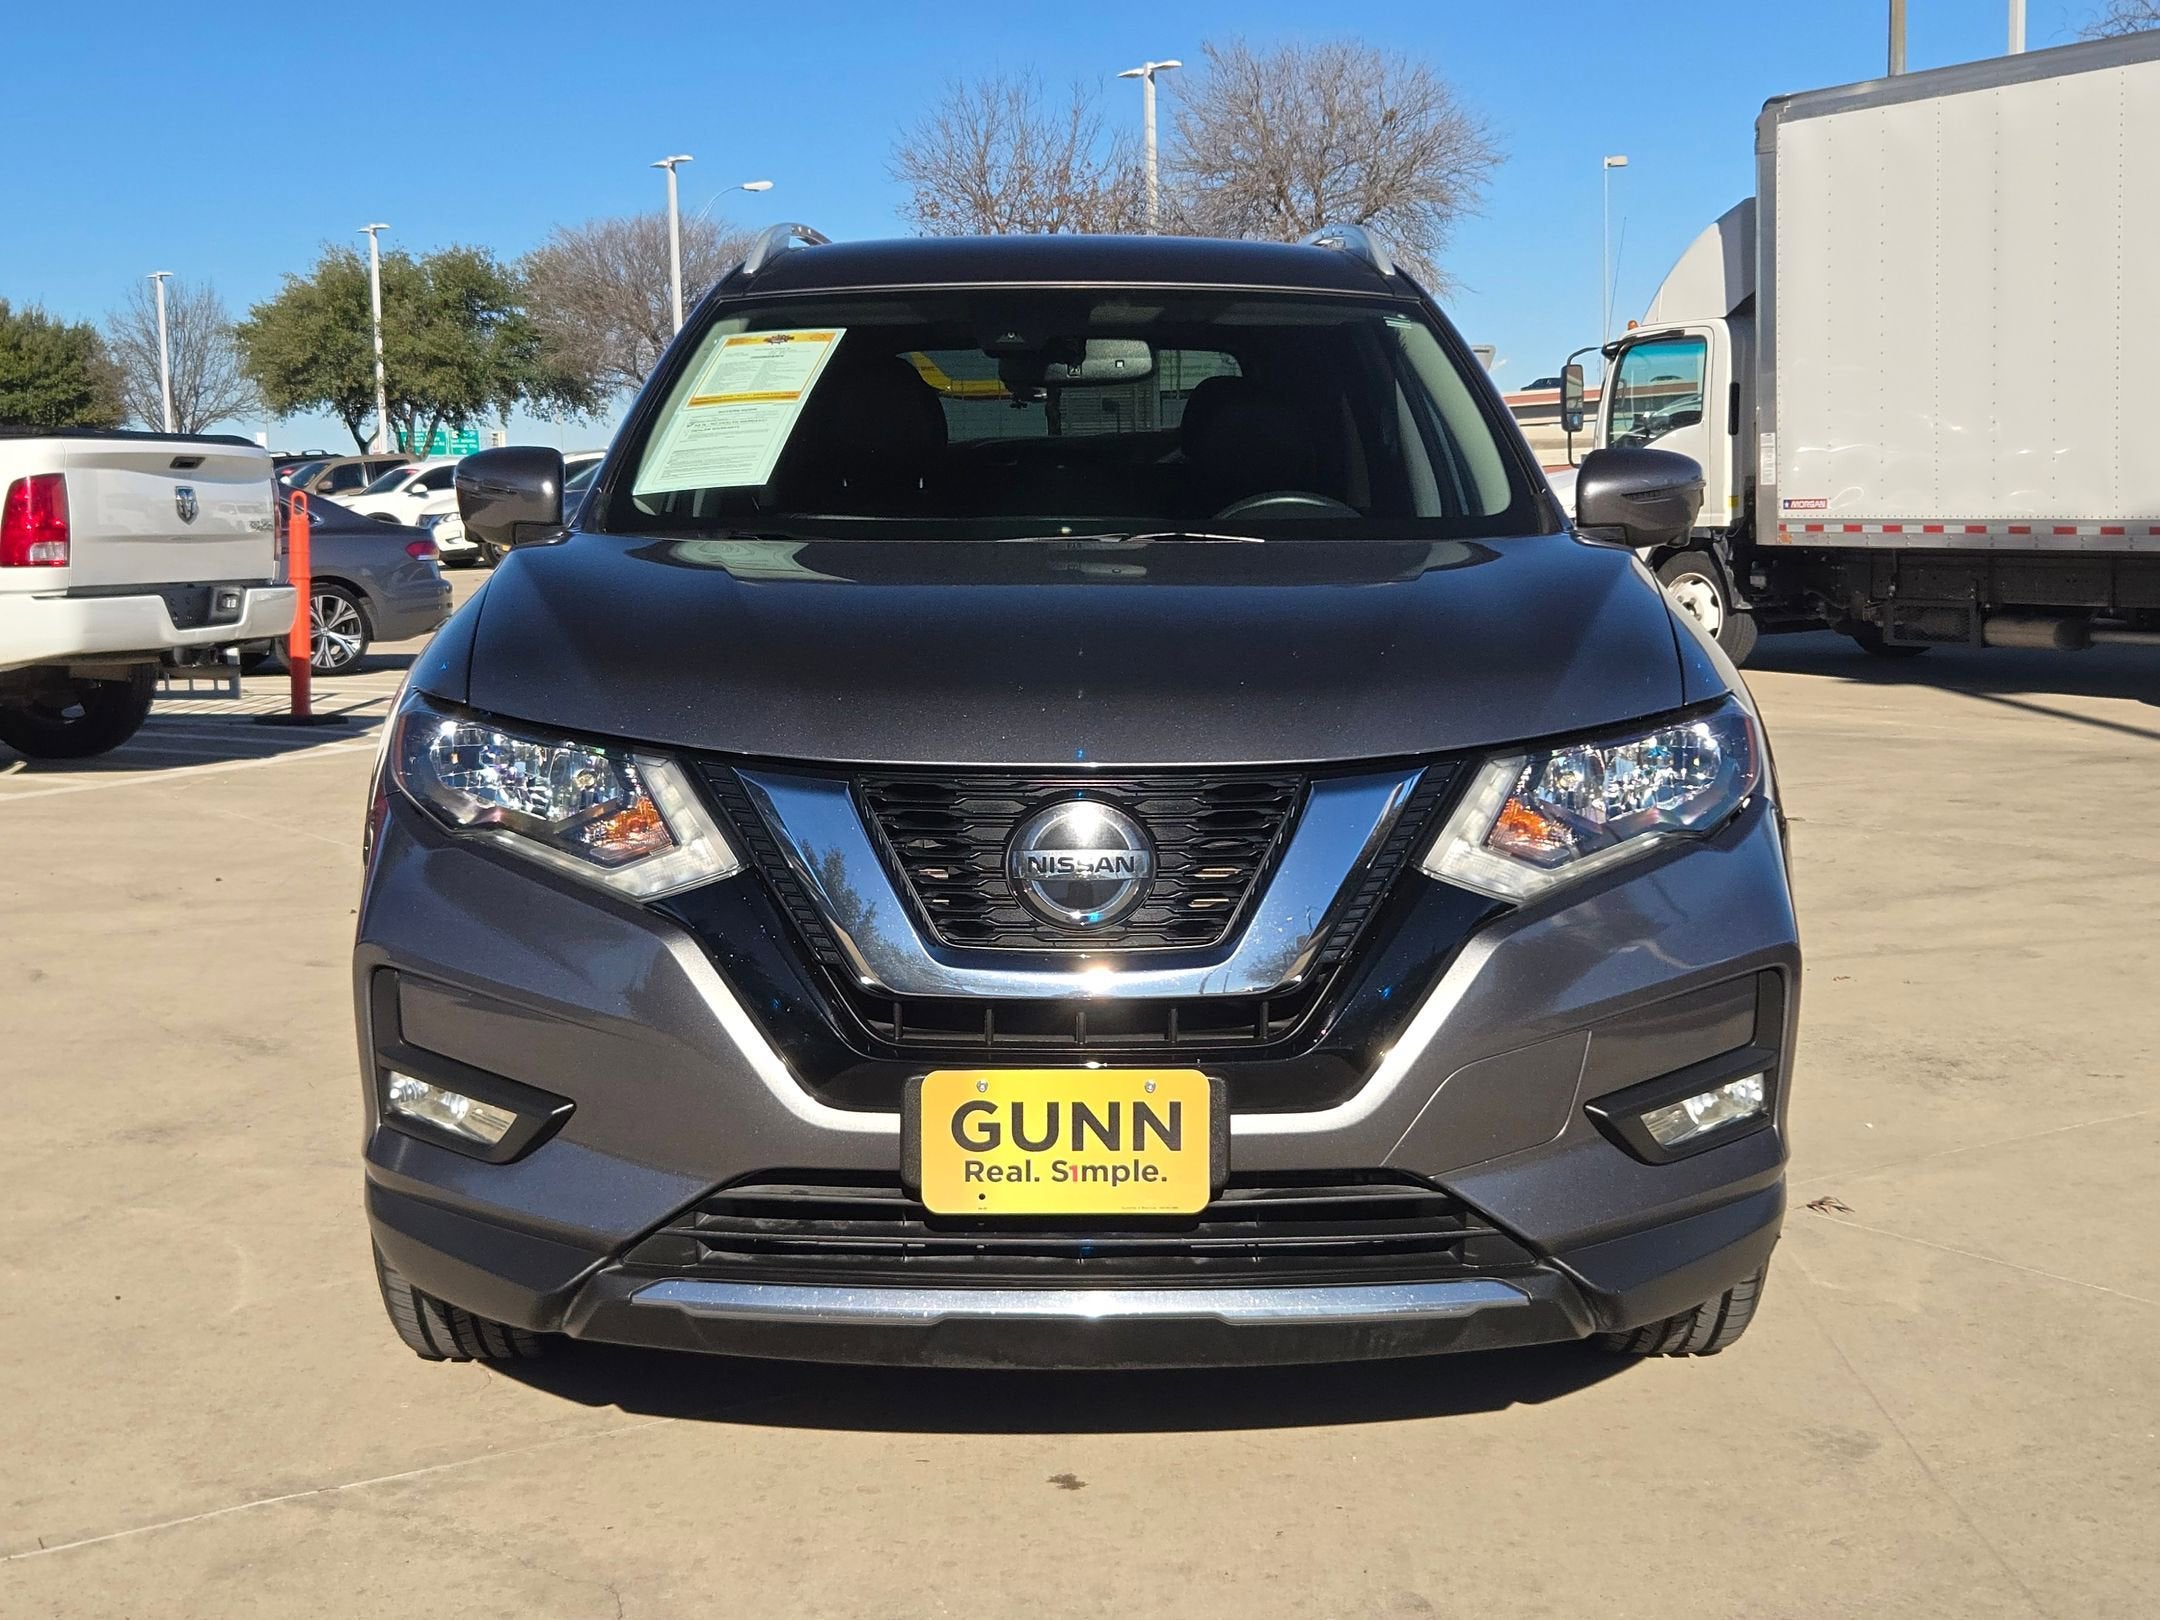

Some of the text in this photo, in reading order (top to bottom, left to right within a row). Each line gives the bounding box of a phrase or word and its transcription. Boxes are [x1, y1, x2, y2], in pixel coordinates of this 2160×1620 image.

[1790, 500, 1826, 508] MORGAN
[1027, 856, 1135, 873] NISSAN
[951, 1100, 1182, 1152] GUNN
[965, 1159, 1040, 1183] Real.
